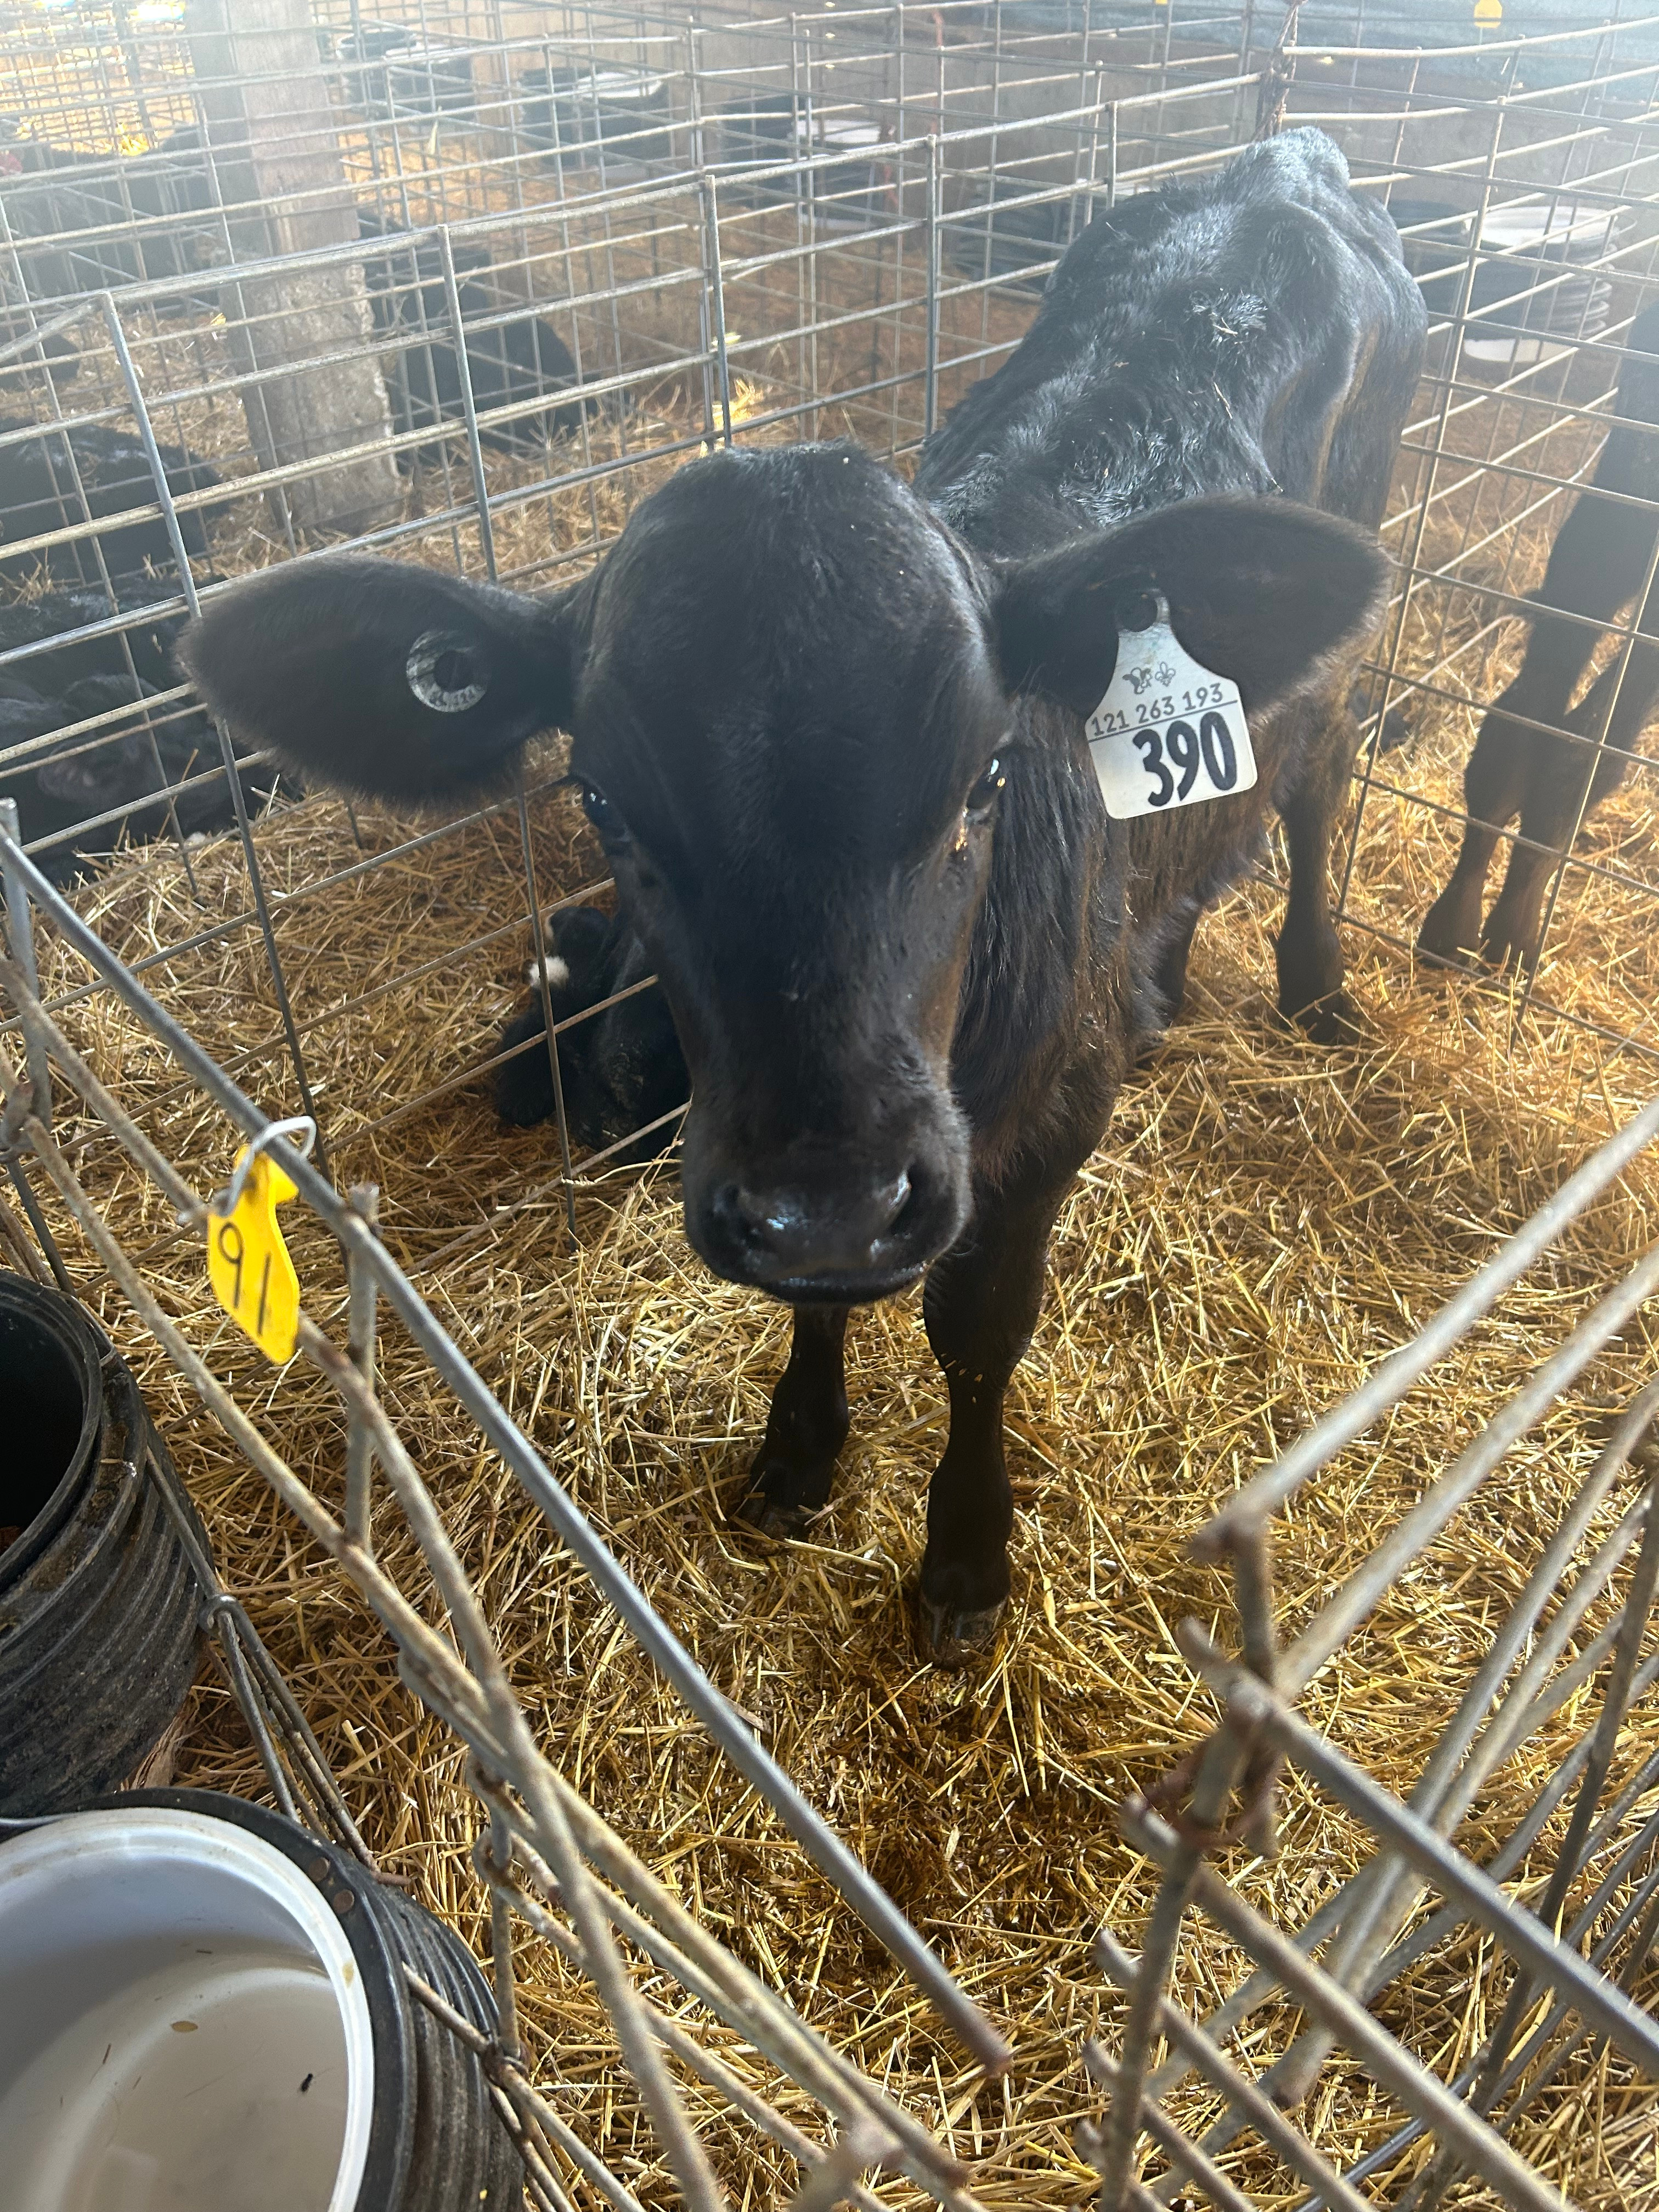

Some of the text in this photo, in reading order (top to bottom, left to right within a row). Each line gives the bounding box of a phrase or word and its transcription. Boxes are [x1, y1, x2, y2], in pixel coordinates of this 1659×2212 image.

[1092, 682, 1223, 736] 121 263 193
[1132, 712, 1238, 806] 390
[218, 1222, 272, 1336] 91
